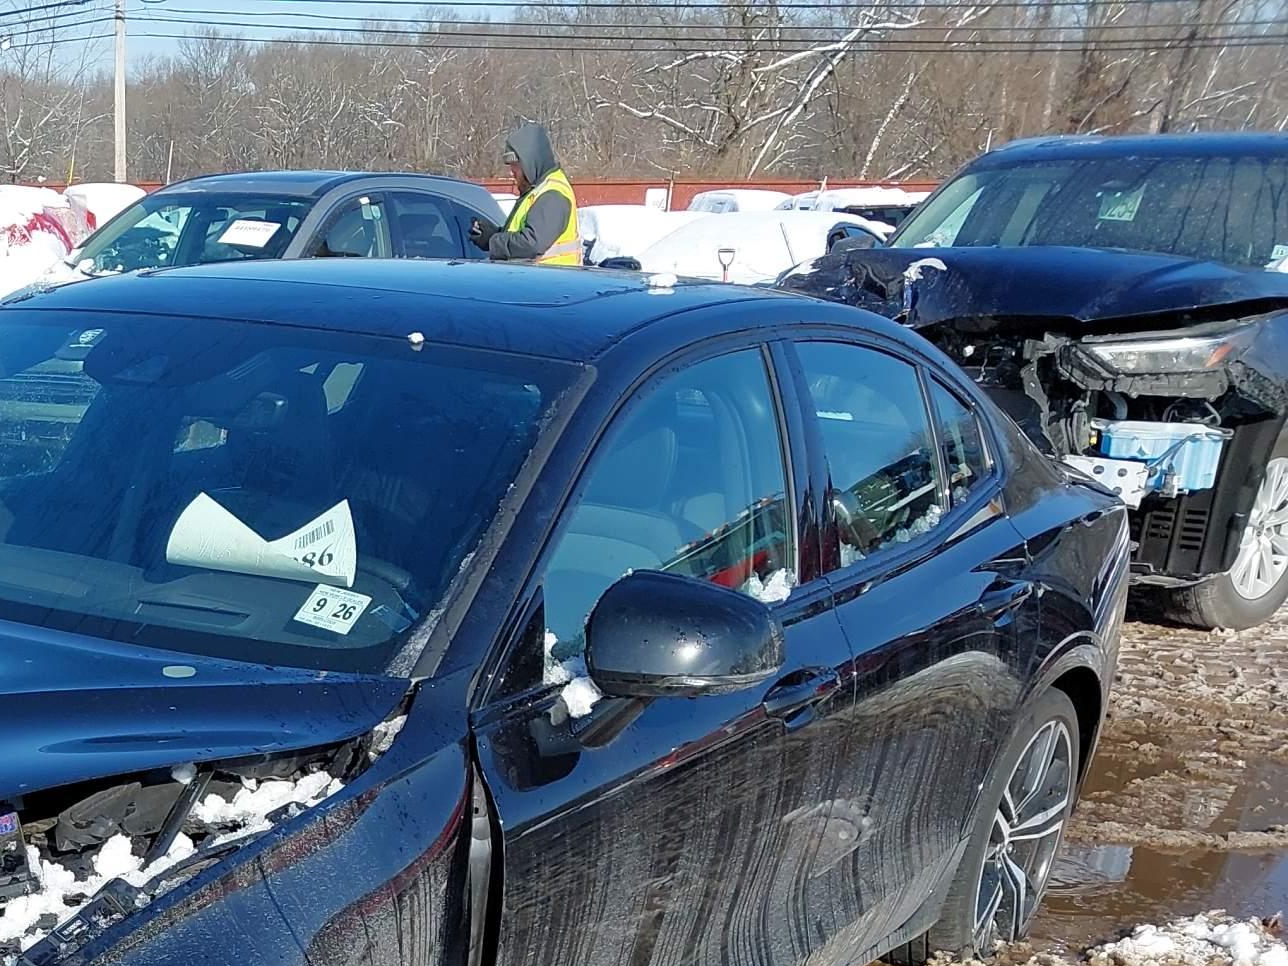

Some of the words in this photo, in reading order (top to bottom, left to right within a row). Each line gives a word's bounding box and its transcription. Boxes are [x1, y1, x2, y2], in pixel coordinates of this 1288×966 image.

[293, 543, 334, 568] 86
[312, 597, 328, 612] 9
[332, 603, 357, 620] 26
